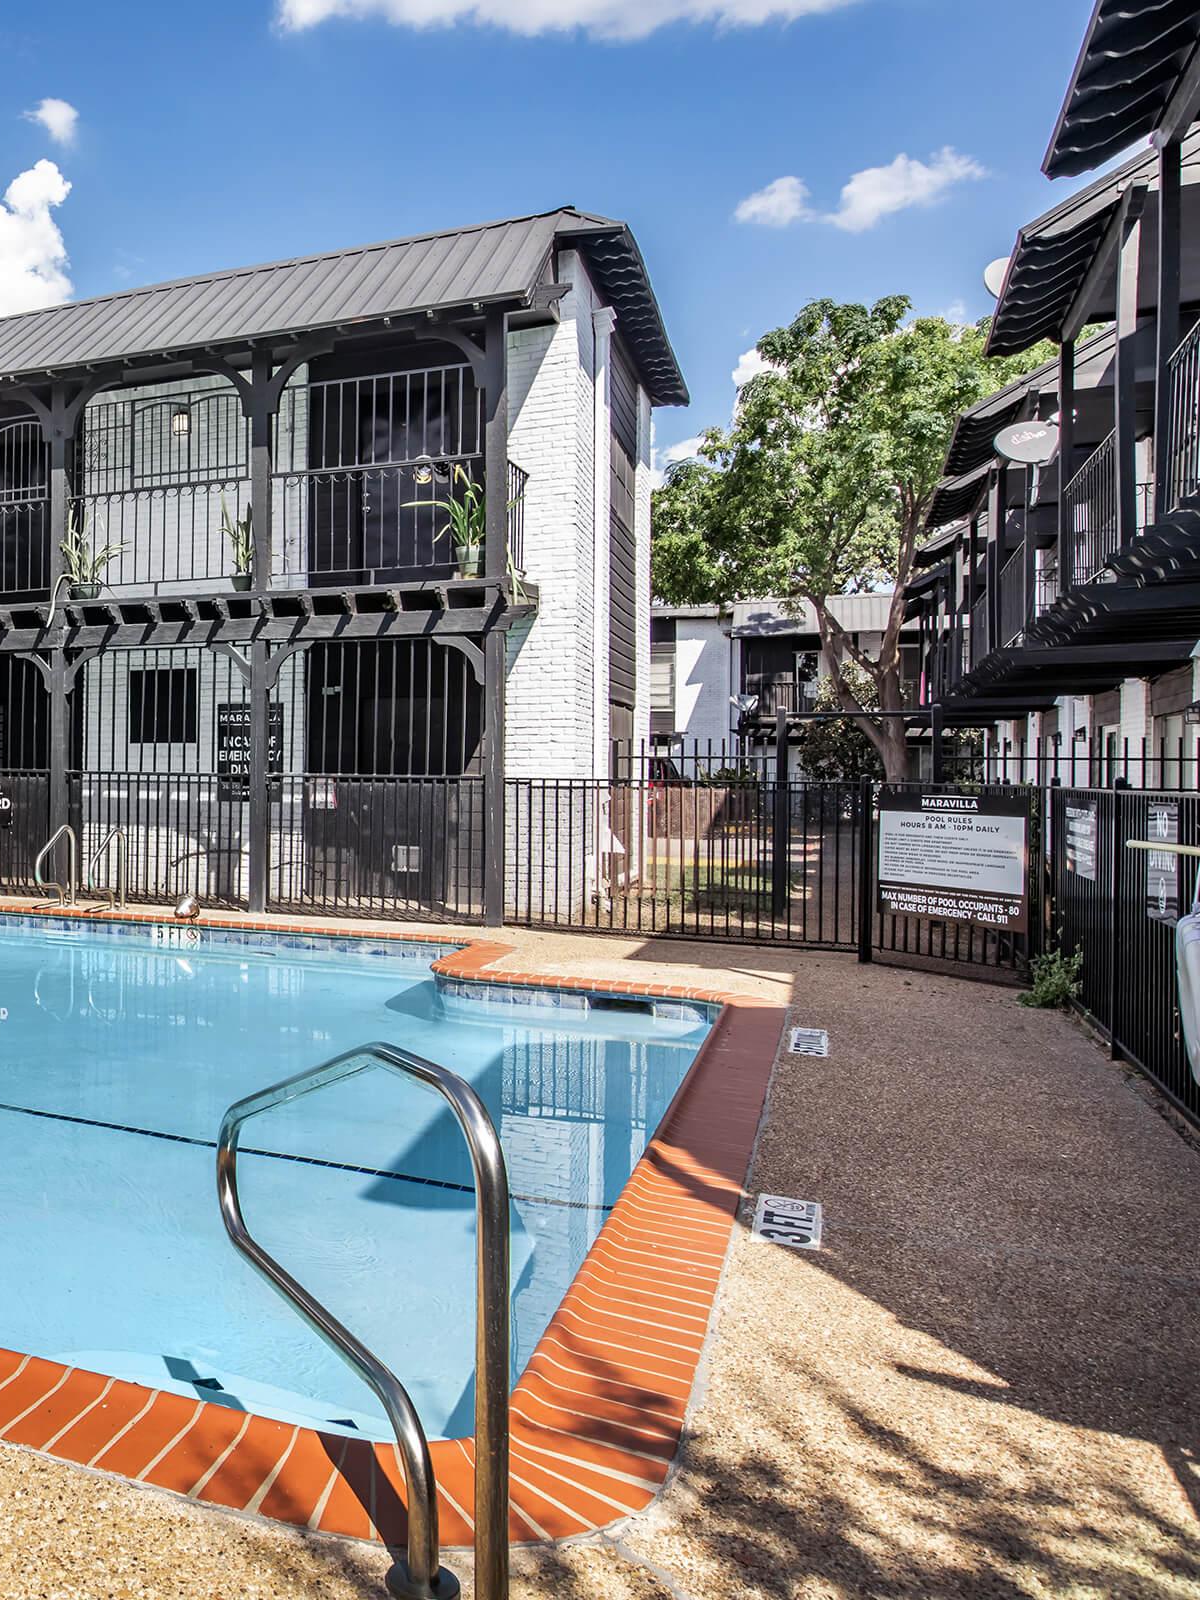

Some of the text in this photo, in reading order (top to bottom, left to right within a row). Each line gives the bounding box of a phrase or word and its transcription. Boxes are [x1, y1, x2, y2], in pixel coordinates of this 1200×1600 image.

[921, 798, 978, 809] MARAVILLA
[925, 815, 945, 823] POOL
[1157, 811, 1169, 837] NO
[900, 821, 926, 829] HOURS
[953, 824, 974, 832] 10PM
[976, 825, 1000, 833] DAILY
[881, 891, 897, 901] MAX
[897, 893, 927, 905] NUMBER
[927, 896, 937, 905] OF
[938, 898, 958, 908] POOL
[958, 900, 1004, 914] OCCUPANTS
[1008, 906, 1020, 916] 80
[890, 901, 898, 910] IN
[899, 902, 917, 912] CASE
[917, 904, 927, 913] OF
[928, 906, 972, 920] EMERGENCY
[977, 912, 996, 923] CALL
[997, 914, 1009, 924] 911
[157, 926, 182, 941] 5 FT
[760, 1229, 811, 1243] 3
